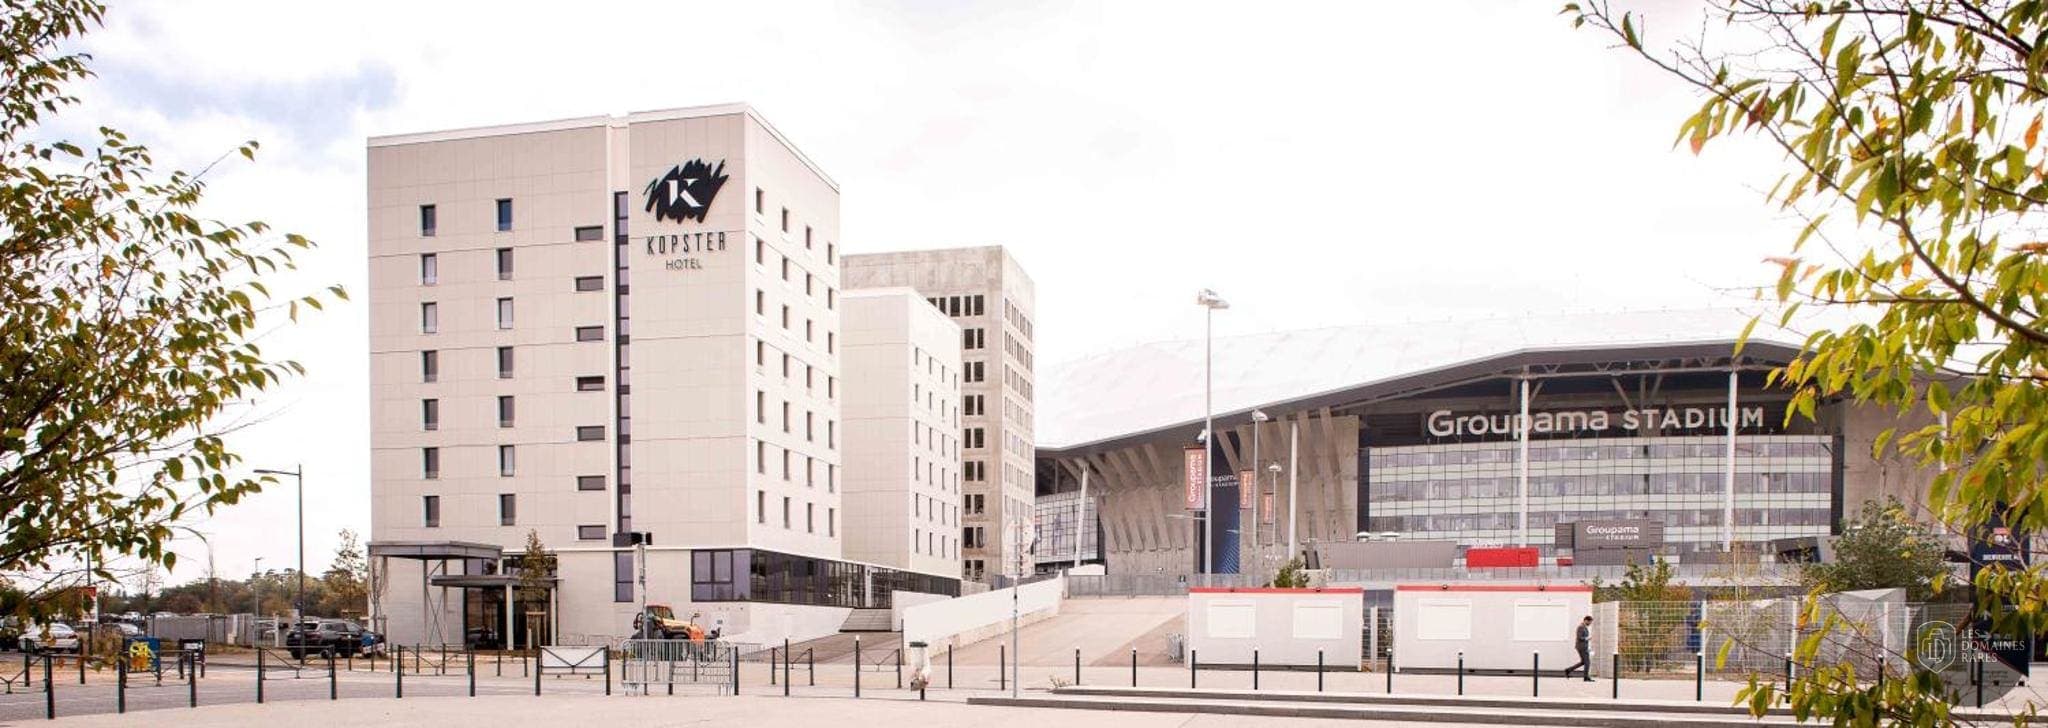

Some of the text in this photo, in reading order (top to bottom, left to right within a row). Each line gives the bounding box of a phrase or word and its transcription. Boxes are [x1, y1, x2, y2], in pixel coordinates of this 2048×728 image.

[647, 232, 726, 255] KOPSTER
[665, 259, 703, 270] HOTEL
[1428, 406, 1764, 440] Groupama STADIUM
[1586, 525, 1640, 535] Groupama
